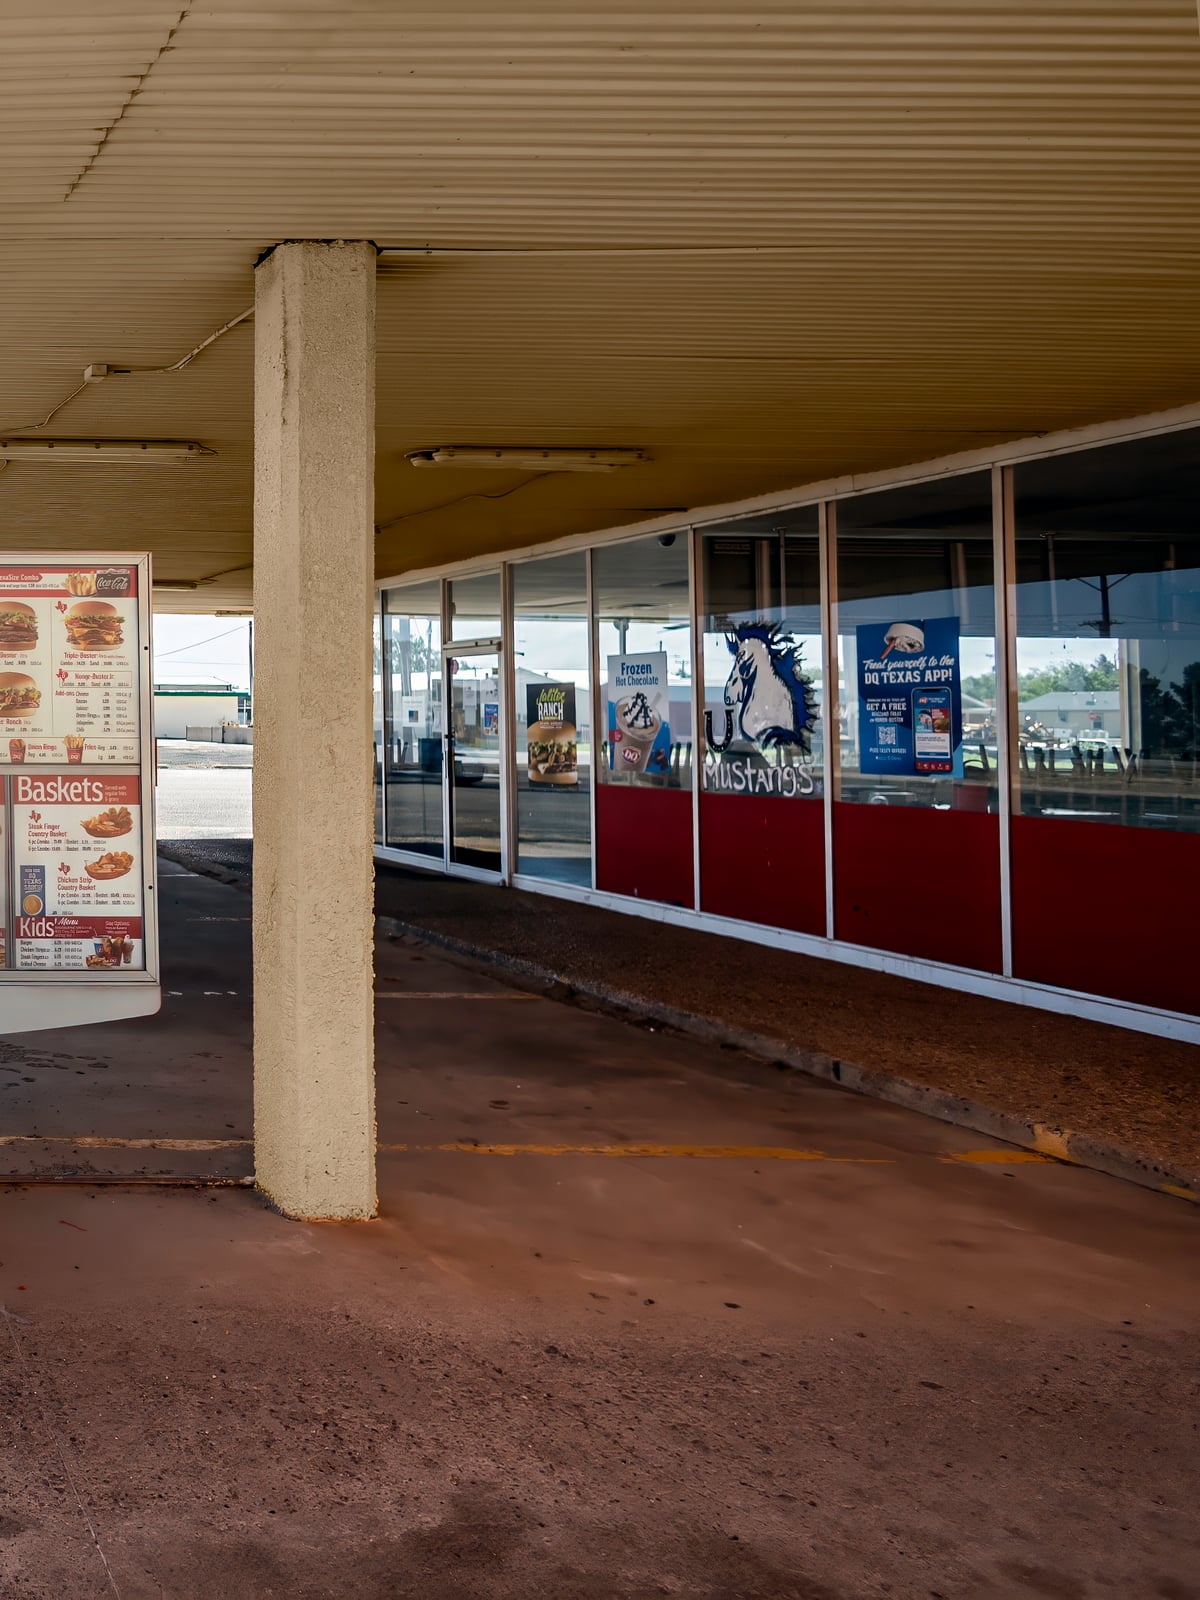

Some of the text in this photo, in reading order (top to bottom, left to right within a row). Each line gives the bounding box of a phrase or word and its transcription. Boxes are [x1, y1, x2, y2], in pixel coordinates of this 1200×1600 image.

[97, 576, 128, 590] Coca-Cola
[621, 662, 652, 676] Frozen
[863, 655, 955, 672] Treat yourself to the
[615, 675, 659, 687] Hot Chocolate
[864, 668, 953, 685] DQ TEXAS APP!
[538, 702, 564, 720] RANCH
[866, 702, 907, 711] GET A FREE
[623, 749, 639, 762] DQ
[17, 775, 103, 802] Baskets
[44, 823, 60, 831] Finger
[20, 917, 57, 937] Kids'
[58, 917, 79, 925] Menu
